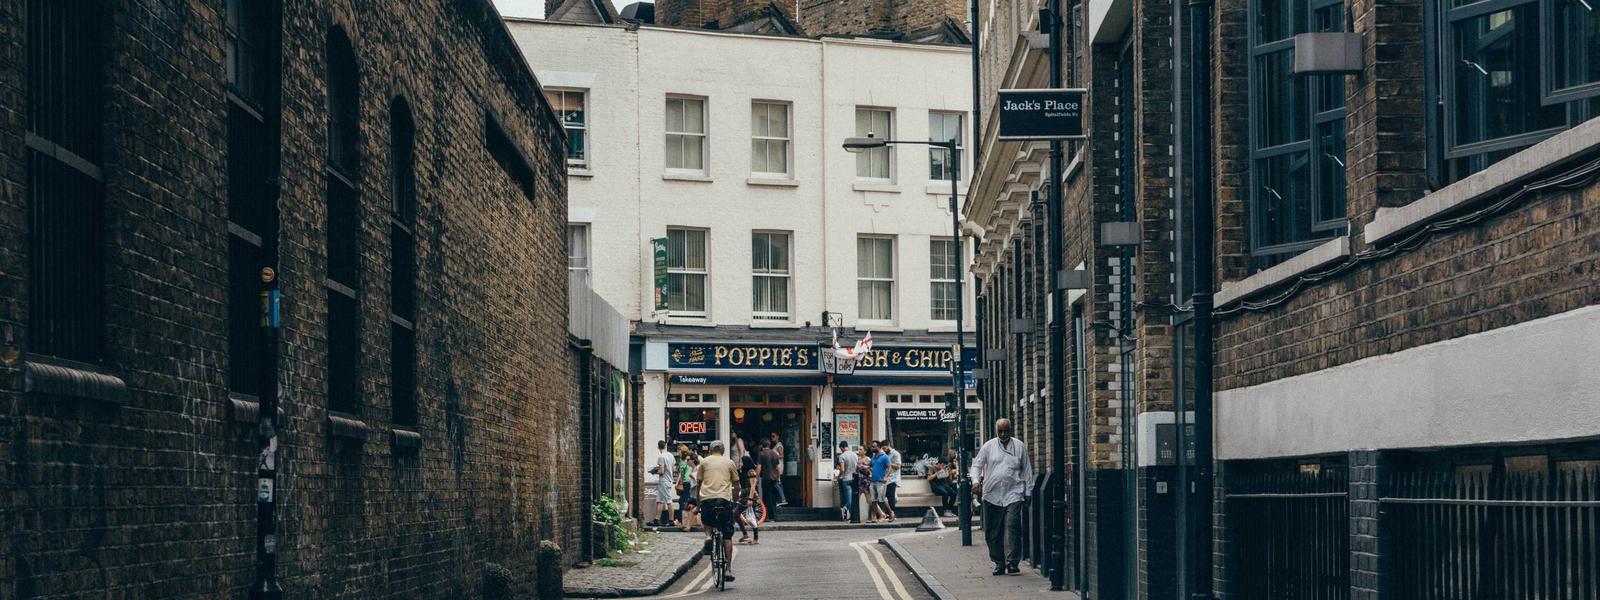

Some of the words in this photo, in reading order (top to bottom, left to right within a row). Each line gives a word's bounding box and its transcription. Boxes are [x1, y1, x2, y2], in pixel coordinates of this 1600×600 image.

[1004, 100, 1041, 111] Jack's
[1044, 100, 1078, 111] Place
[714, 346, 808, 366] POPPIE'S
[892, 352, 902, 364] &
[905, 349, 953, 368] CHIP
[838, 364, 852, 372] CHIPS
[678, 376, 707, 384] Takeaway
[680, 422, 705, 433] OPEN
